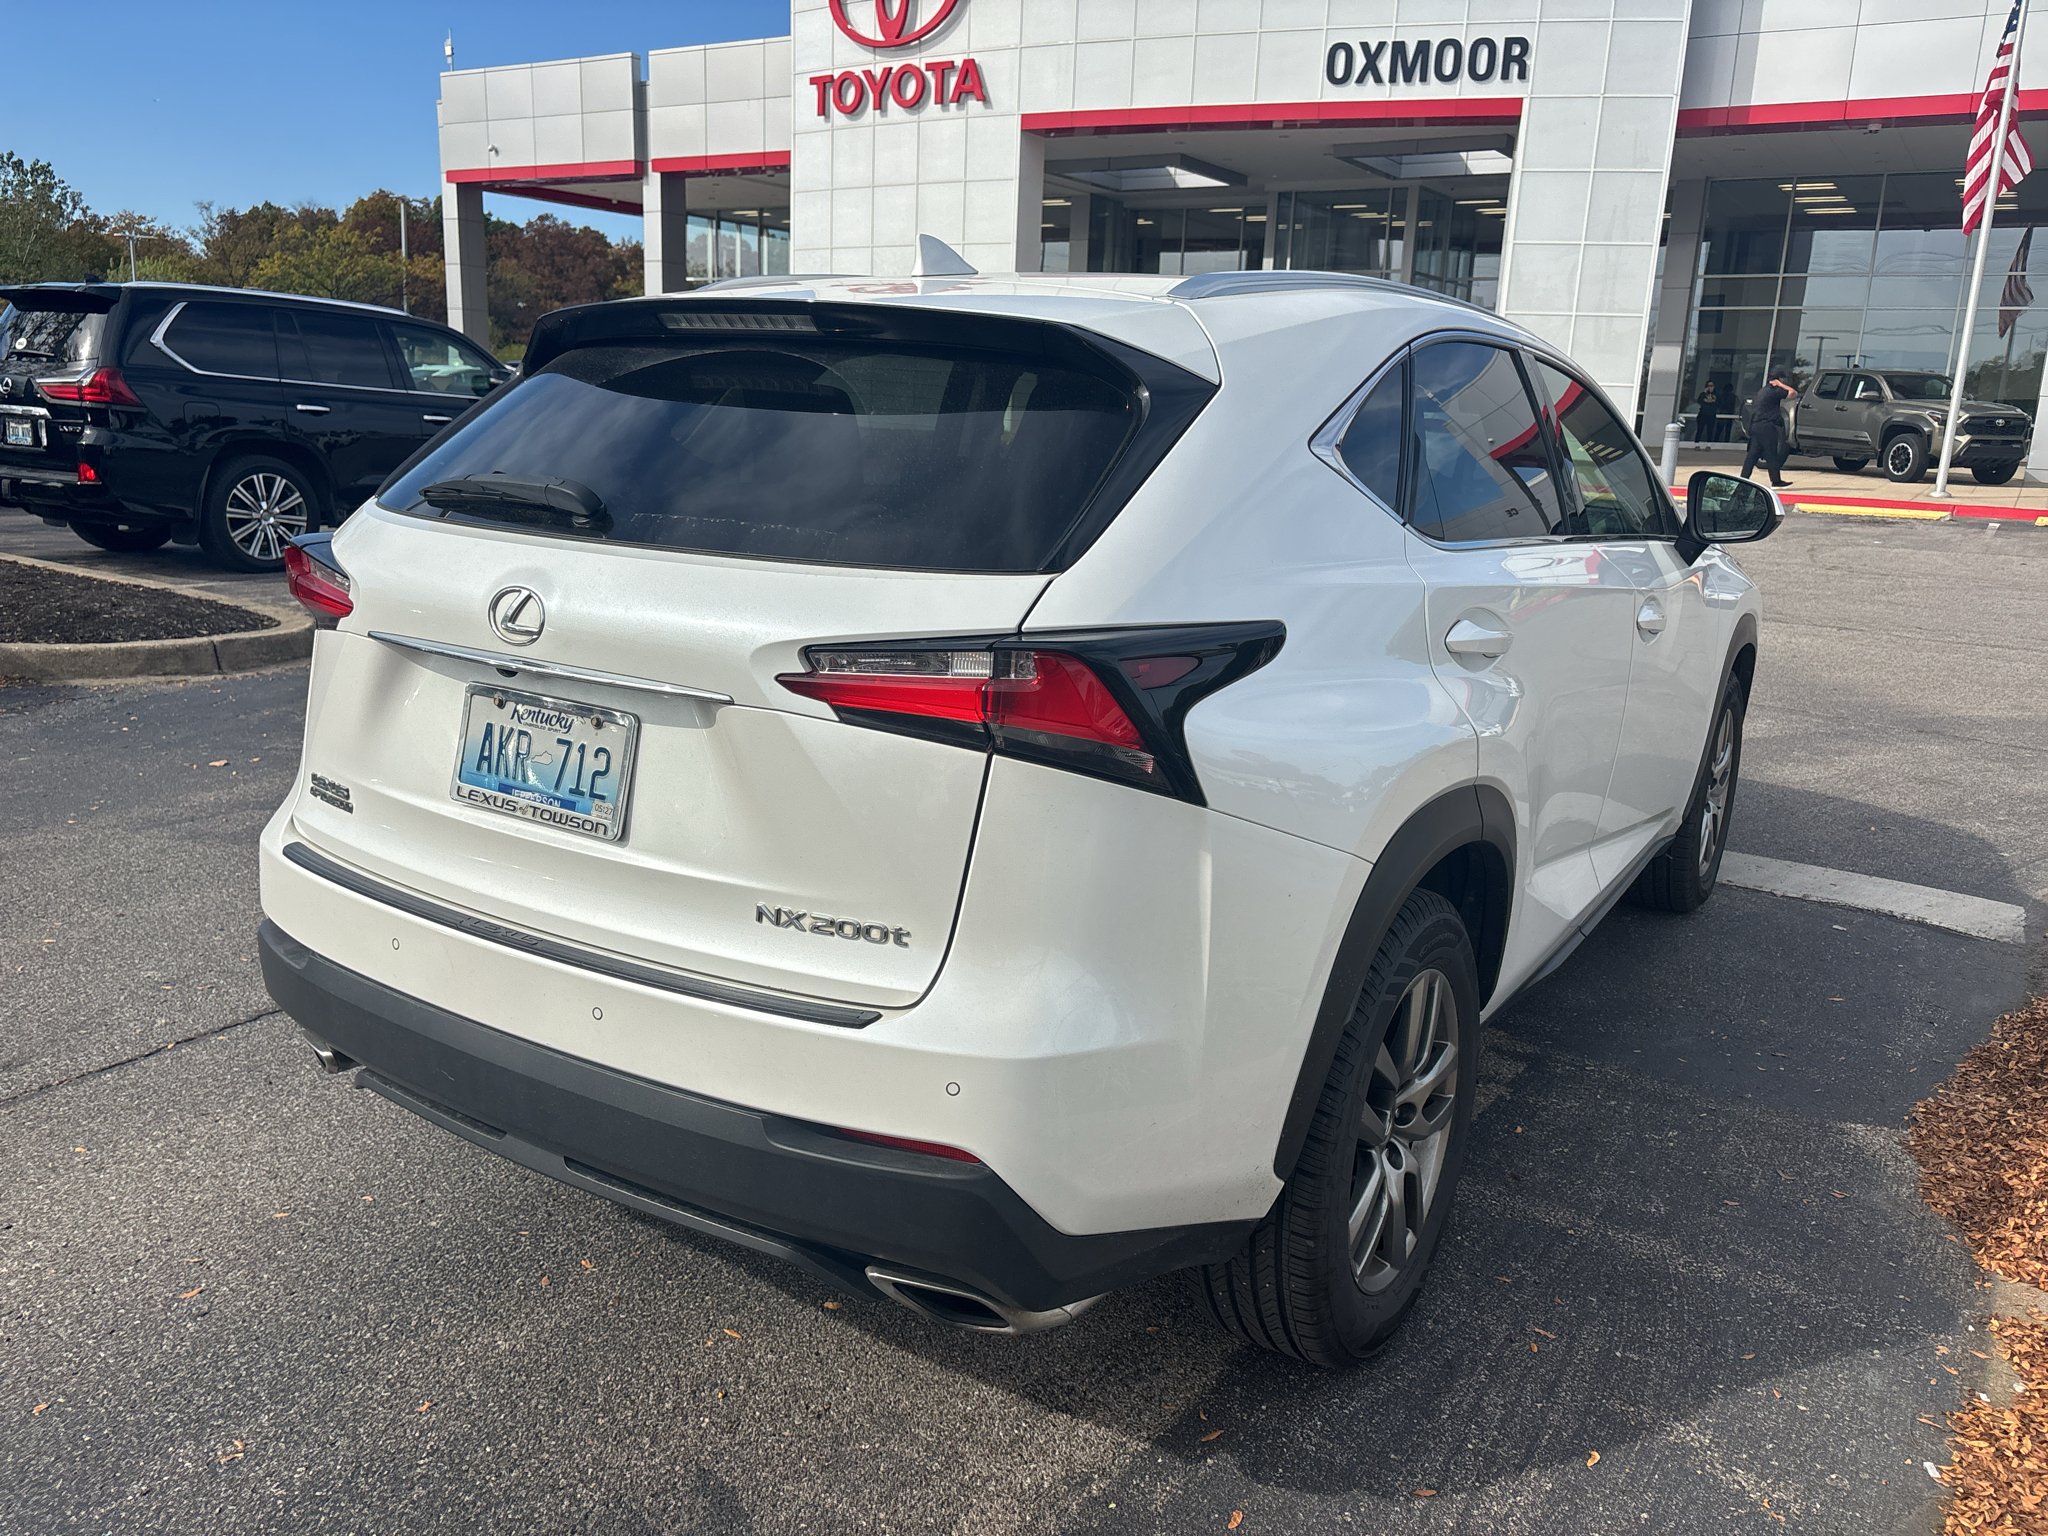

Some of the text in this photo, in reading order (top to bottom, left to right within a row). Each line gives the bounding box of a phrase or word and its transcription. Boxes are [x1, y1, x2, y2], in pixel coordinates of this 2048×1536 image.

[1326, 36, 1529, 86] OXMOOR
[809, 58, 986, 117] TOYOTA
[510, 704, 575, 735] Kentucky
[475, 722, 612, 801] AKR 712
[456, 785, 518, 812] LEXUS
[526, 805, 608, 836] TOWSON
[755, 901, 913, 949] NX200t
